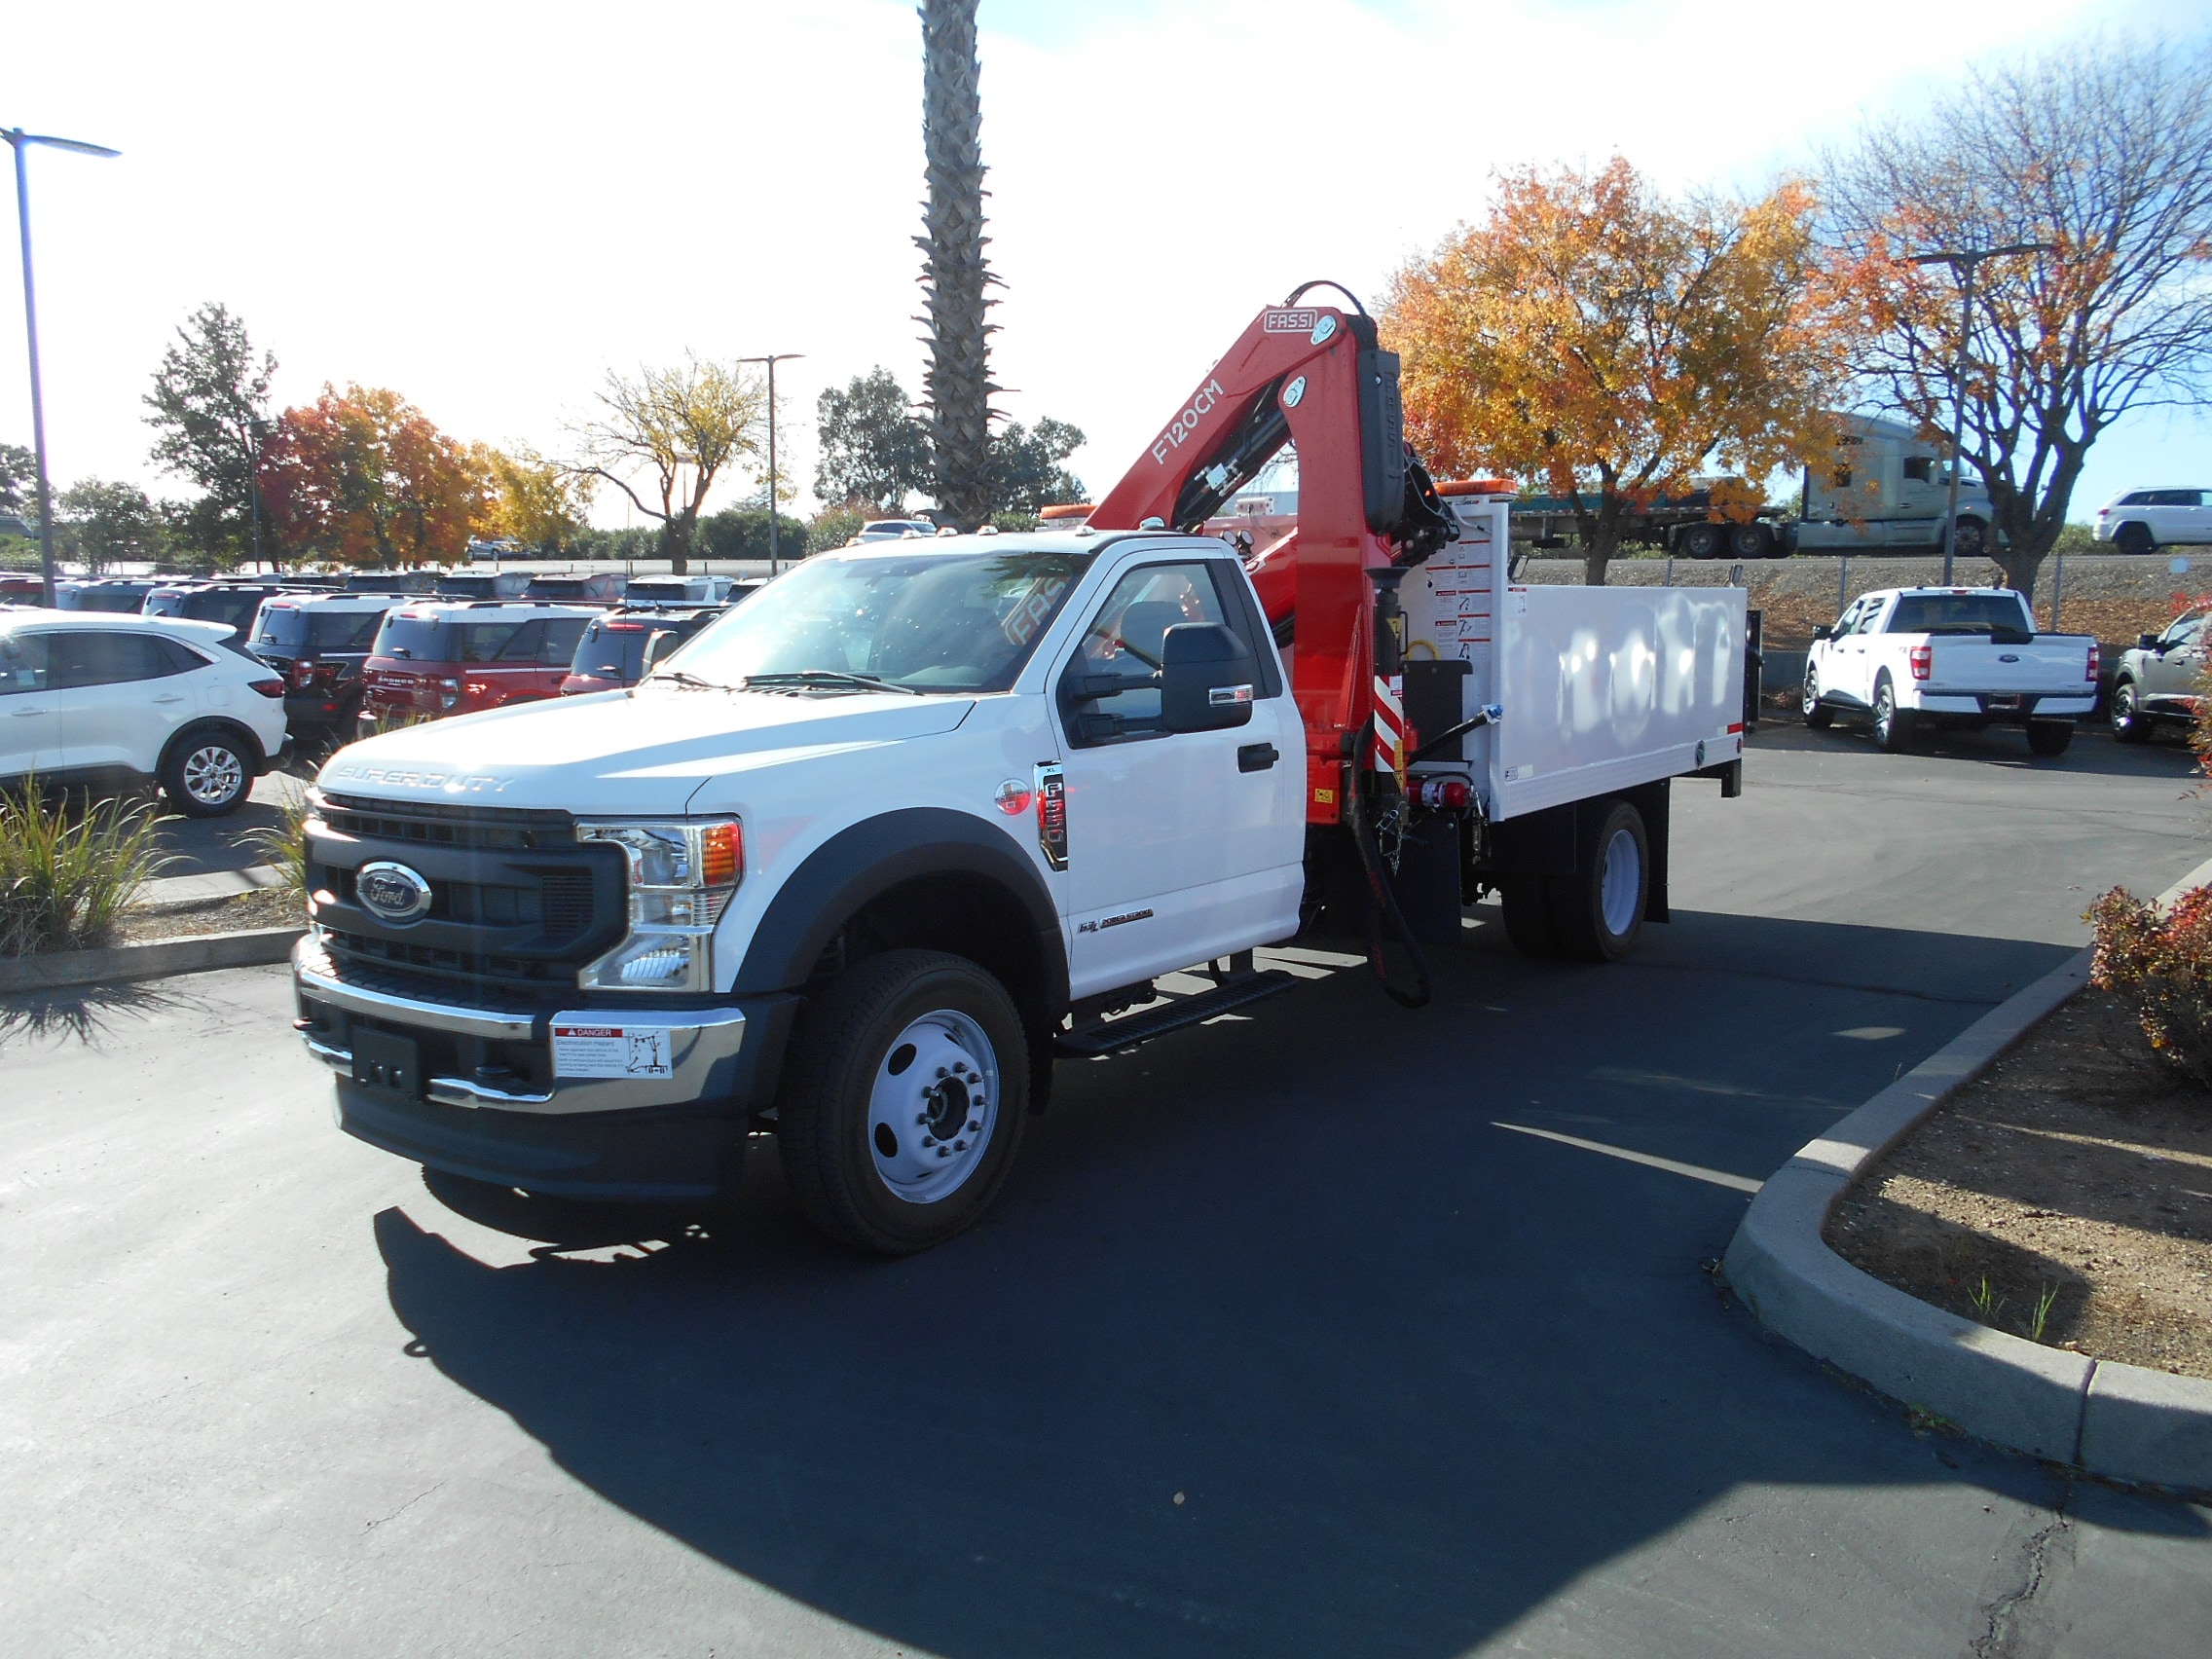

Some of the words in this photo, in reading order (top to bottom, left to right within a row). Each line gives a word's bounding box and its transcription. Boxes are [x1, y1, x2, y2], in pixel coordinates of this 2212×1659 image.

[1268, 313, 1313, 329] FASSI
[1152, 379, 1224, 465] F120CM
[338, 765, 420, 787] SUPER
[419, 772, 515, 793] DUTY
[371, 877, 407, 906] Ford
[576, 1028, 612, 1037] DANGER
